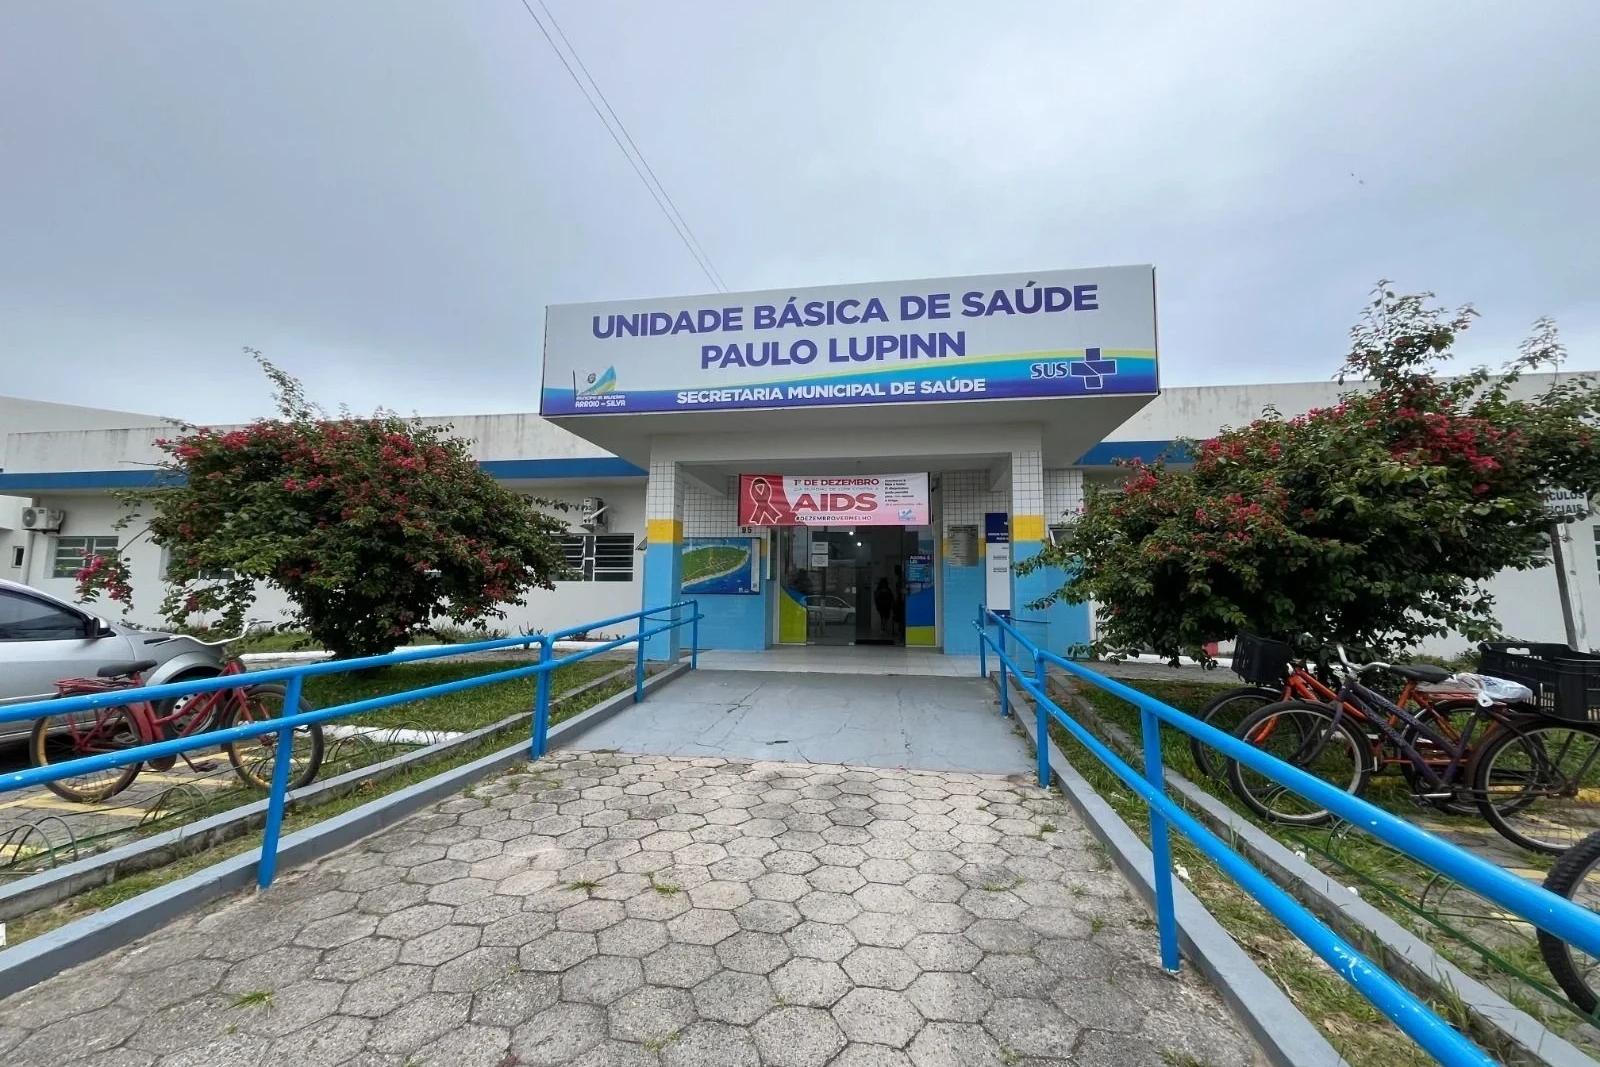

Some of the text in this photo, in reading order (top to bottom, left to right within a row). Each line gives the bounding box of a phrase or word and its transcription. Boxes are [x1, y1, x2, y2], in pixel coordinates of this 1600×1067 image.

[592, 280, 1099, 339] UNIDADE BÁSICA DE SAÚDE
[701, 331, 966, 369] PAULO LUPINN
[1030, 361, 1069, 379] SUS
[676, 376, 986, 404] SECRETARIA MUNICIPAL DE SAÚDE
[606, 399, 626, 407] SILVA
[820, 478, 880, 486] DEZEMBRO
[791, 492, 878, 512] AIDS
[1545, 491, 1585, 503] CULOS
